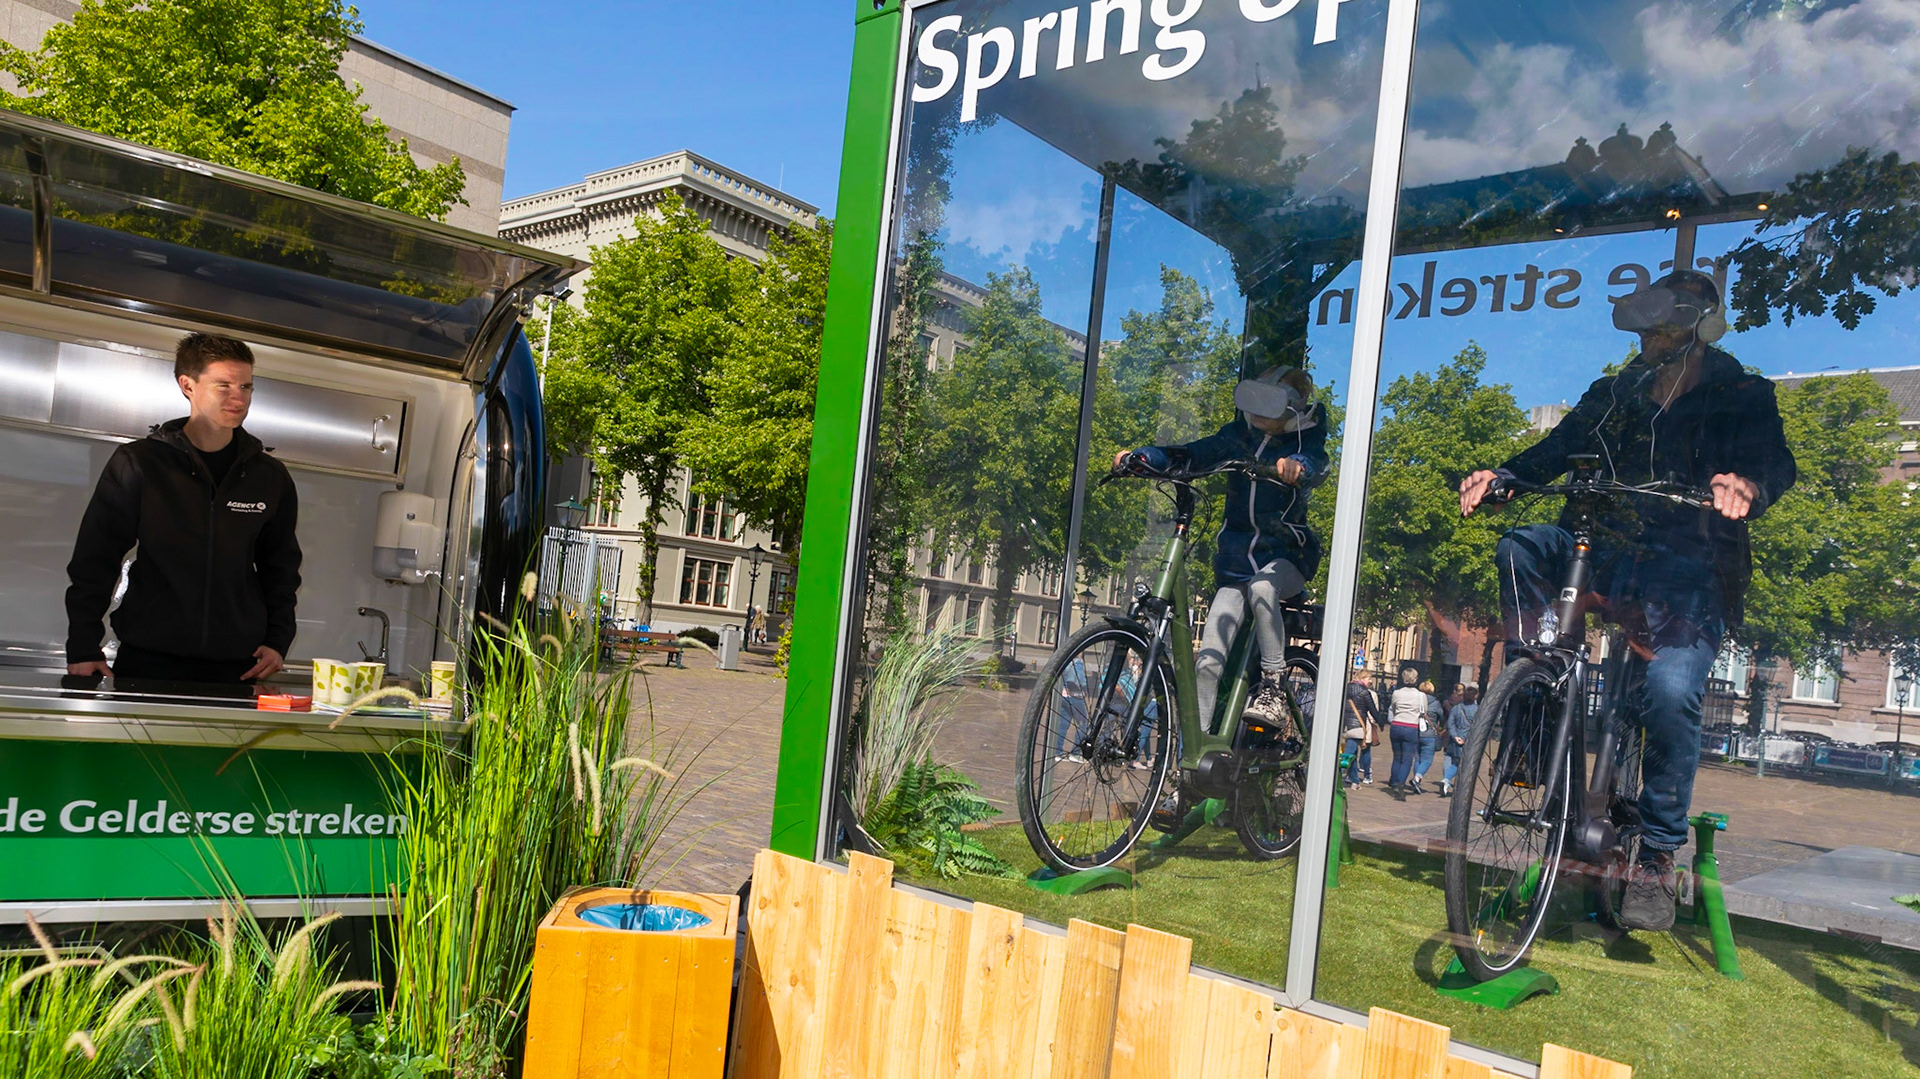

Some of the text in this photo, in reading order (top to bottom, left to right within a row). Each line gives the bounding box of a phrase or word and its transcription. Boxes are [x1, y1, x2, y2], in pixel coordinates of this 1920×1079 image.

[911, 0, 1206, 123] Spring
[226, 501, 256, 509] AGENCY
[0, 797, 407, 835] de Gelderse streken
